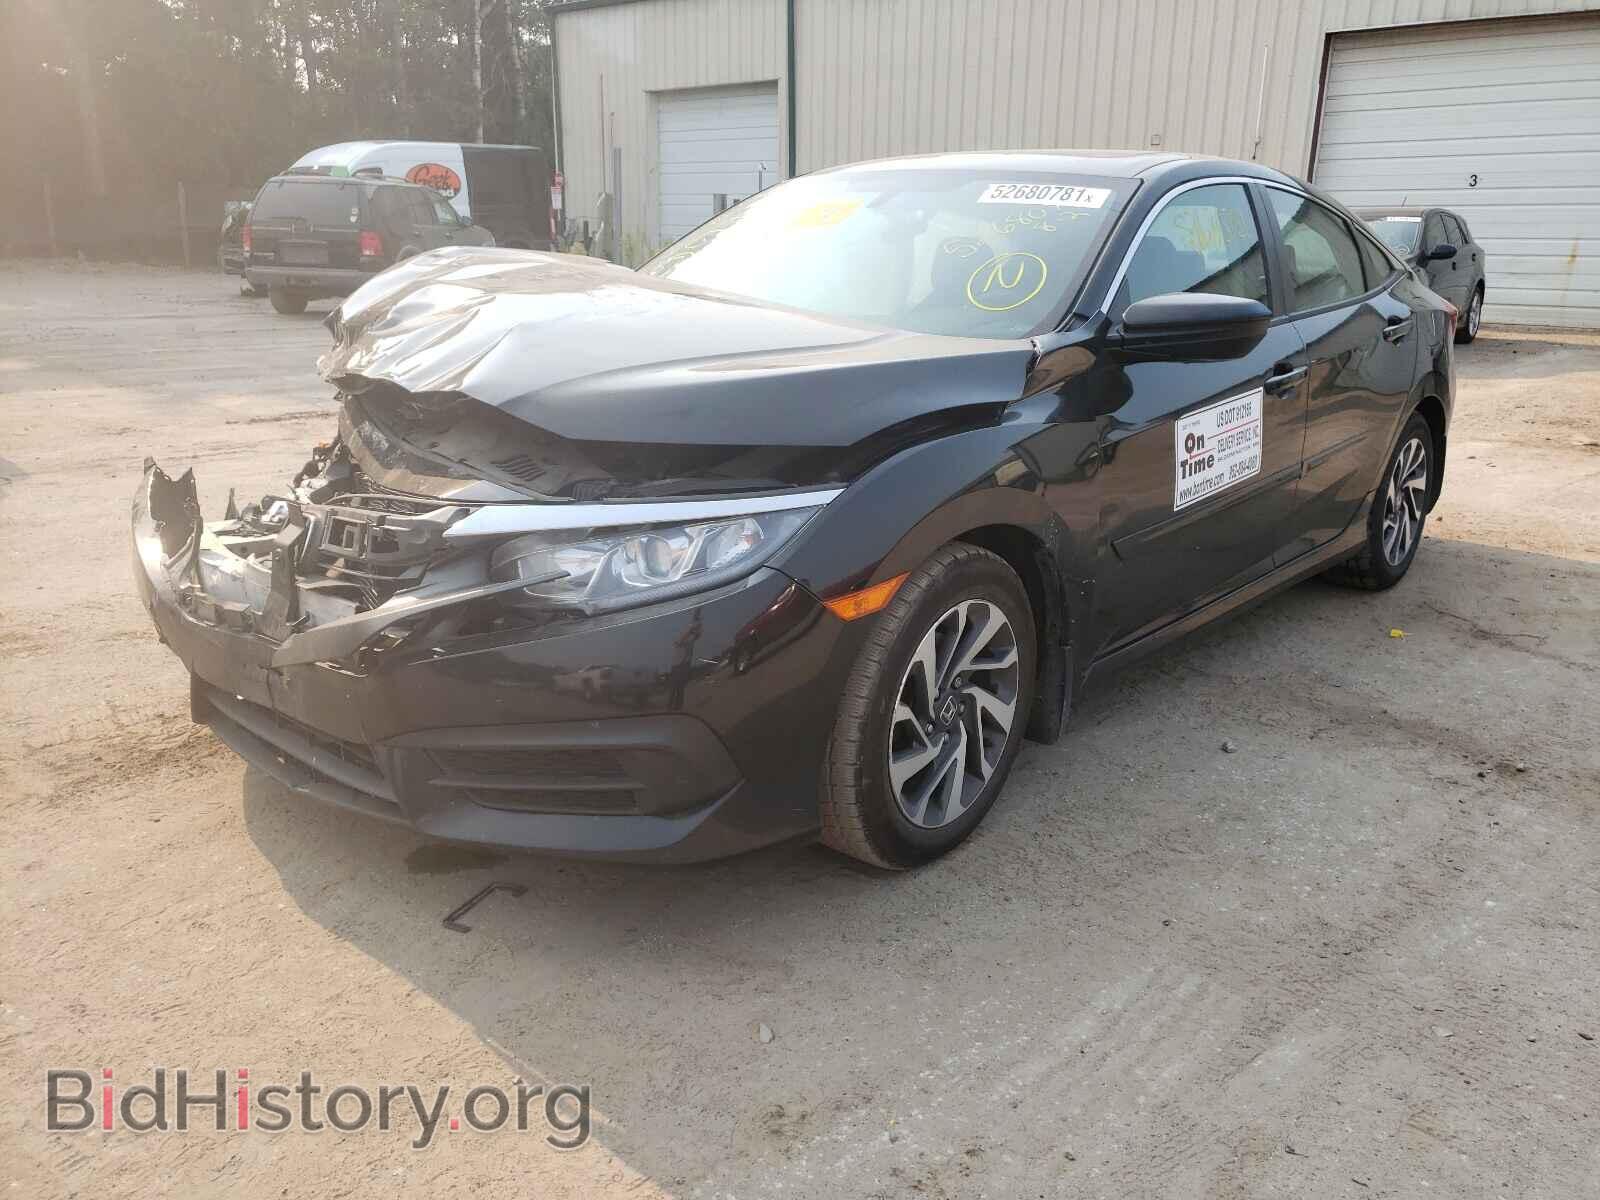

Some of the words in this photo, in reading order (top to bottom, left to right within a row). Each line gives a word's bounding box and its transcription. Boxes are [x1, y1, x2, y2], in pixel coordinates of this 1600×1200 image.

[1468, 174, 1478, 187] 3
[1224, 407, 1235, 425] DOT
[1184, 432, 1205, 454] On
[1180, 454, 1215, 480] Time
